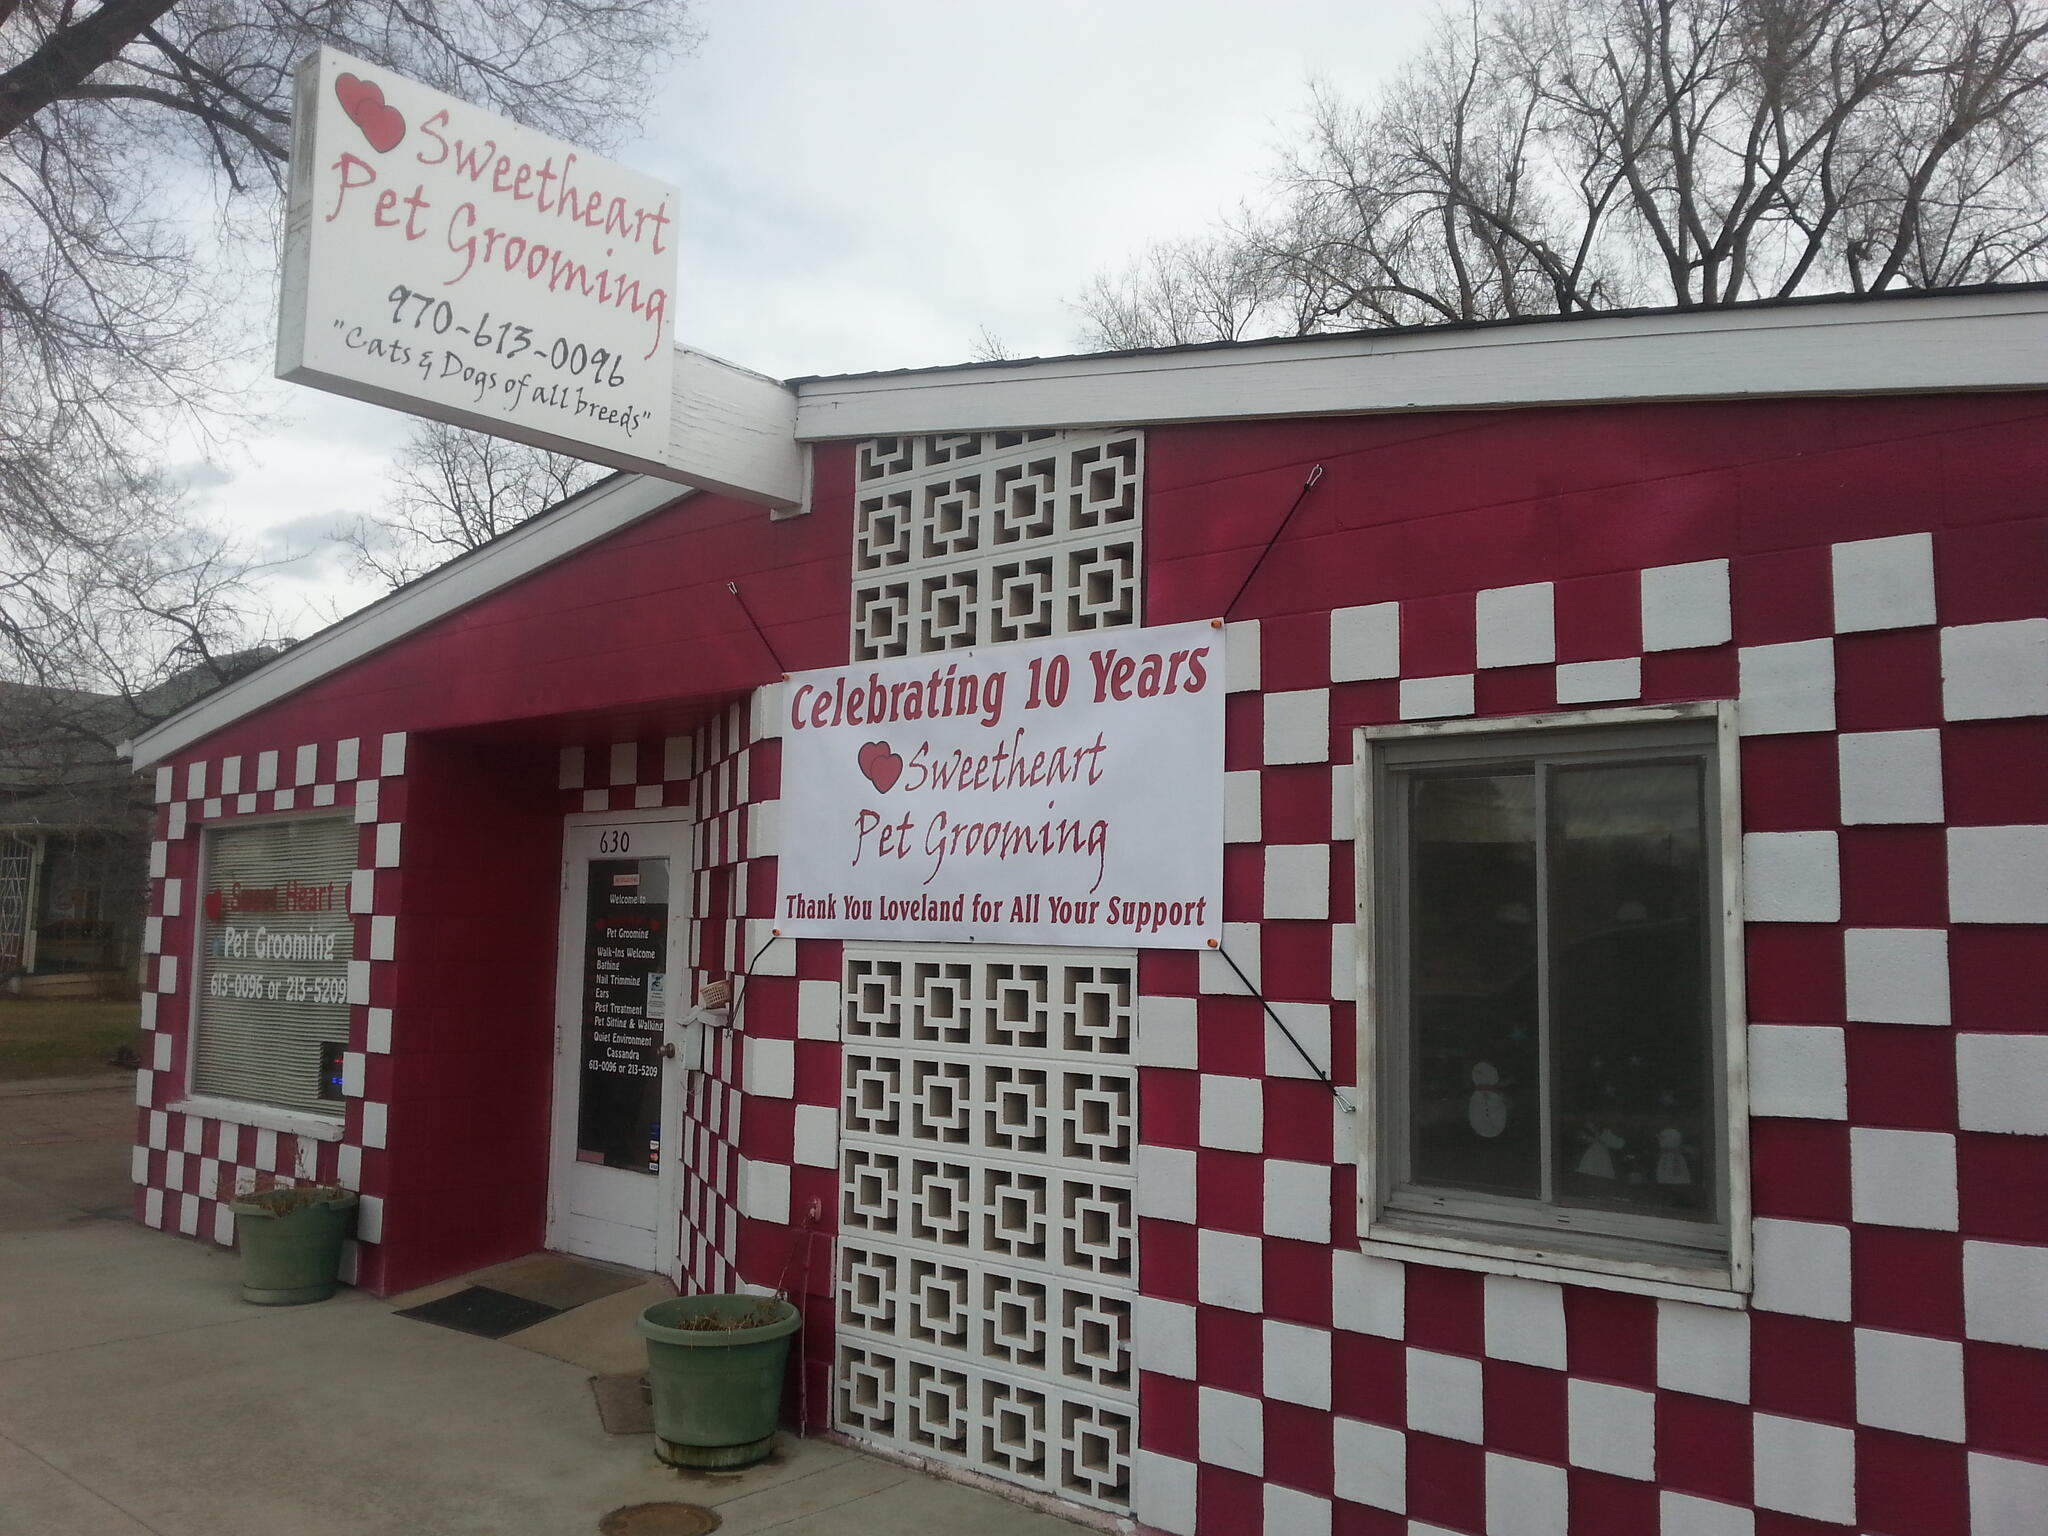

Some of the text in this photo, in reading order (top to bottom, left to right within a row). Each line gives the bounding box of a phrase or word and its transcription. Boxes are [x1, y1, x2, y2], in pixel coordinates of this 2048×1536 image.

[416, 109, 670, 254] Sweetheart
[325, 152, 668, 360] Pet Grooming
[388, 285, 625, 387] 970-613-0096
[333, 319, 651, 438] "Cats & Dogs of all breeds"
[791, 646, 1210, 730] Celebrating 10 Years
[904, 727, 1106, 792] Sweetheart
[600, 830, 630, 853] 630
[852, 801, 1108, 894] Pet Grooming
[609, 894, 647, 905] Welcome to
[786, 894, 1207, 933] Thank You Loveland for All Your Support
[224, 926, 336, 961] Pet Grooming
[606, 928, 649, 939] Pet Grooming
[626, 947, 656, 959] Welcome
[596, 960, 620, 971] Bathing
[210, 972, 348, 1004] 613-0096 or 213-5209
[596, 974, 641, 986] Nail Trimming
[595, 987, 610, 999] Ears
[594, 1002, 609, 1013] Pest
[610, 1003, 643, 1015] Treatment
[594, 1016, 664, 1031] Pet Sitting & Walking
[594, 1031, 652, 1047] Quiet Environment
[606, 1047, 640, 1060] Cassandra
[588, 1059, 658, 1077] 613-0096 or 213-5209
